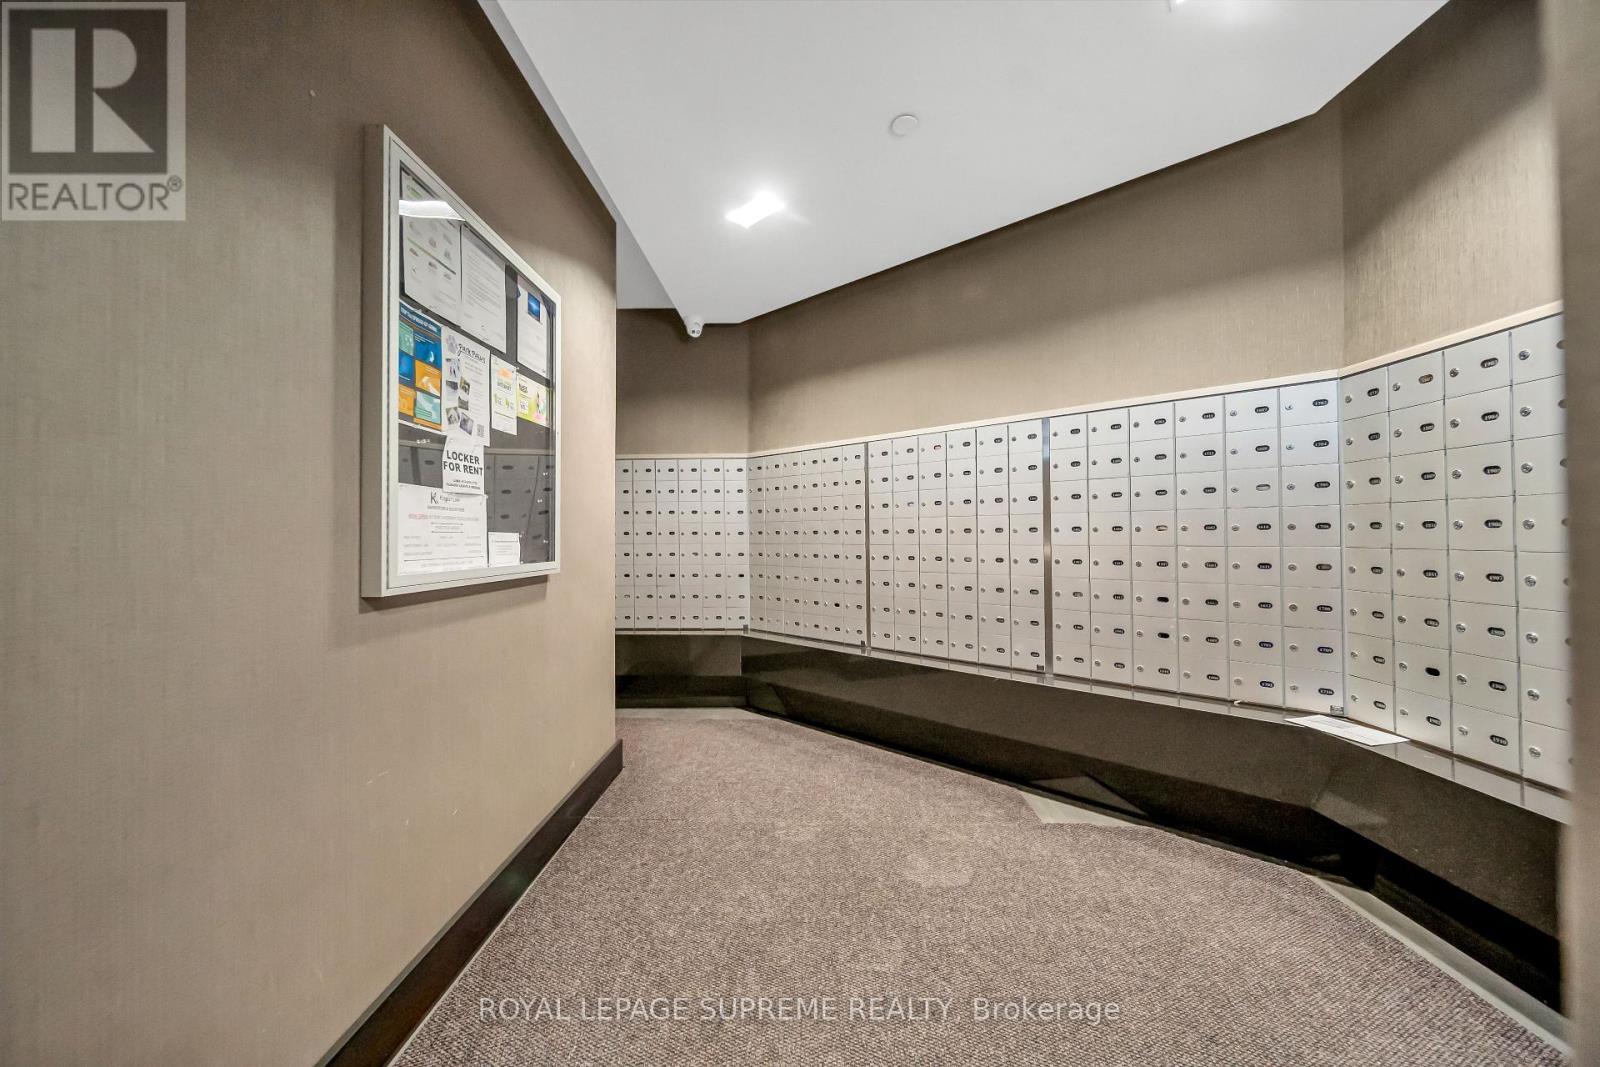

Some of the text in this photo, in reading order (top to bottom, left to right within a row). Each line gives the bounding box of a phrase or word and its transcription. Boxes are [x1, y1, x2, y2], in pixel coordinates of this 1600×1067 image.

[446, 450, 480, 464] LOCKER
[443, 461, 483, 476] FOR RENT
